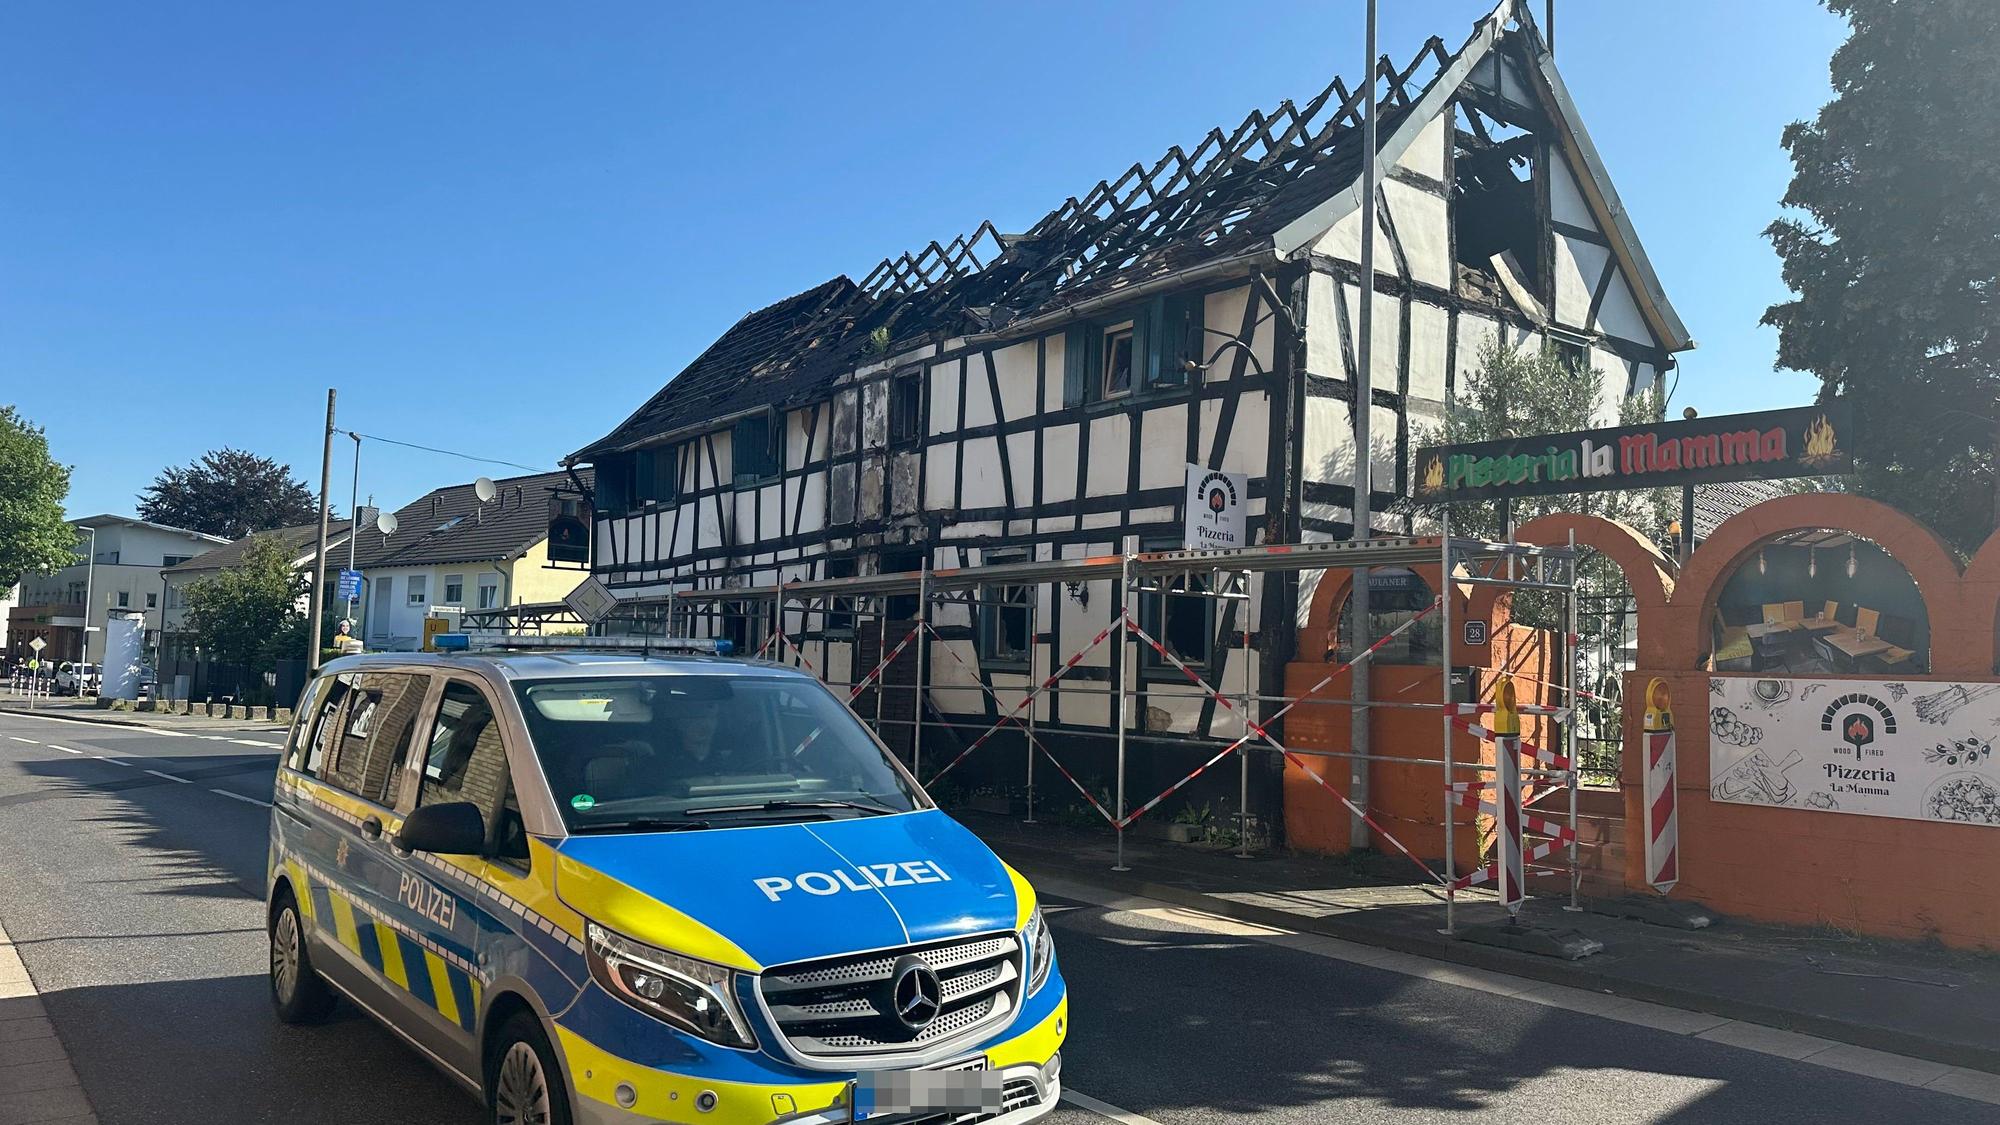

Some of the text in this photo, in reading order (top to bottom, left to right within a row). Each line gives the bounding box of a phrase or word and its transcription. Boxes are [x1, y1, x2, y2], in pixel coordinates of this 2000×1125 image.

[1581, 438, 1615, 478] la
[1618, 427, 1788, 475] Mamma
[1197, 525, 1234, 542] Pizzeria
[1368, 577, 1407, 587] AULANER
[1470, 628, 1481, 639] 28
[1833, 747, 1884, 757] WOOD FIRED
[1822, 763, 1896, 783] Pizzeria
[1829, 782, 1890, 796] La Mamma
[753, 860, 952, 902] POLIZEI
[398, 871, 456, 931] POLIZEI
